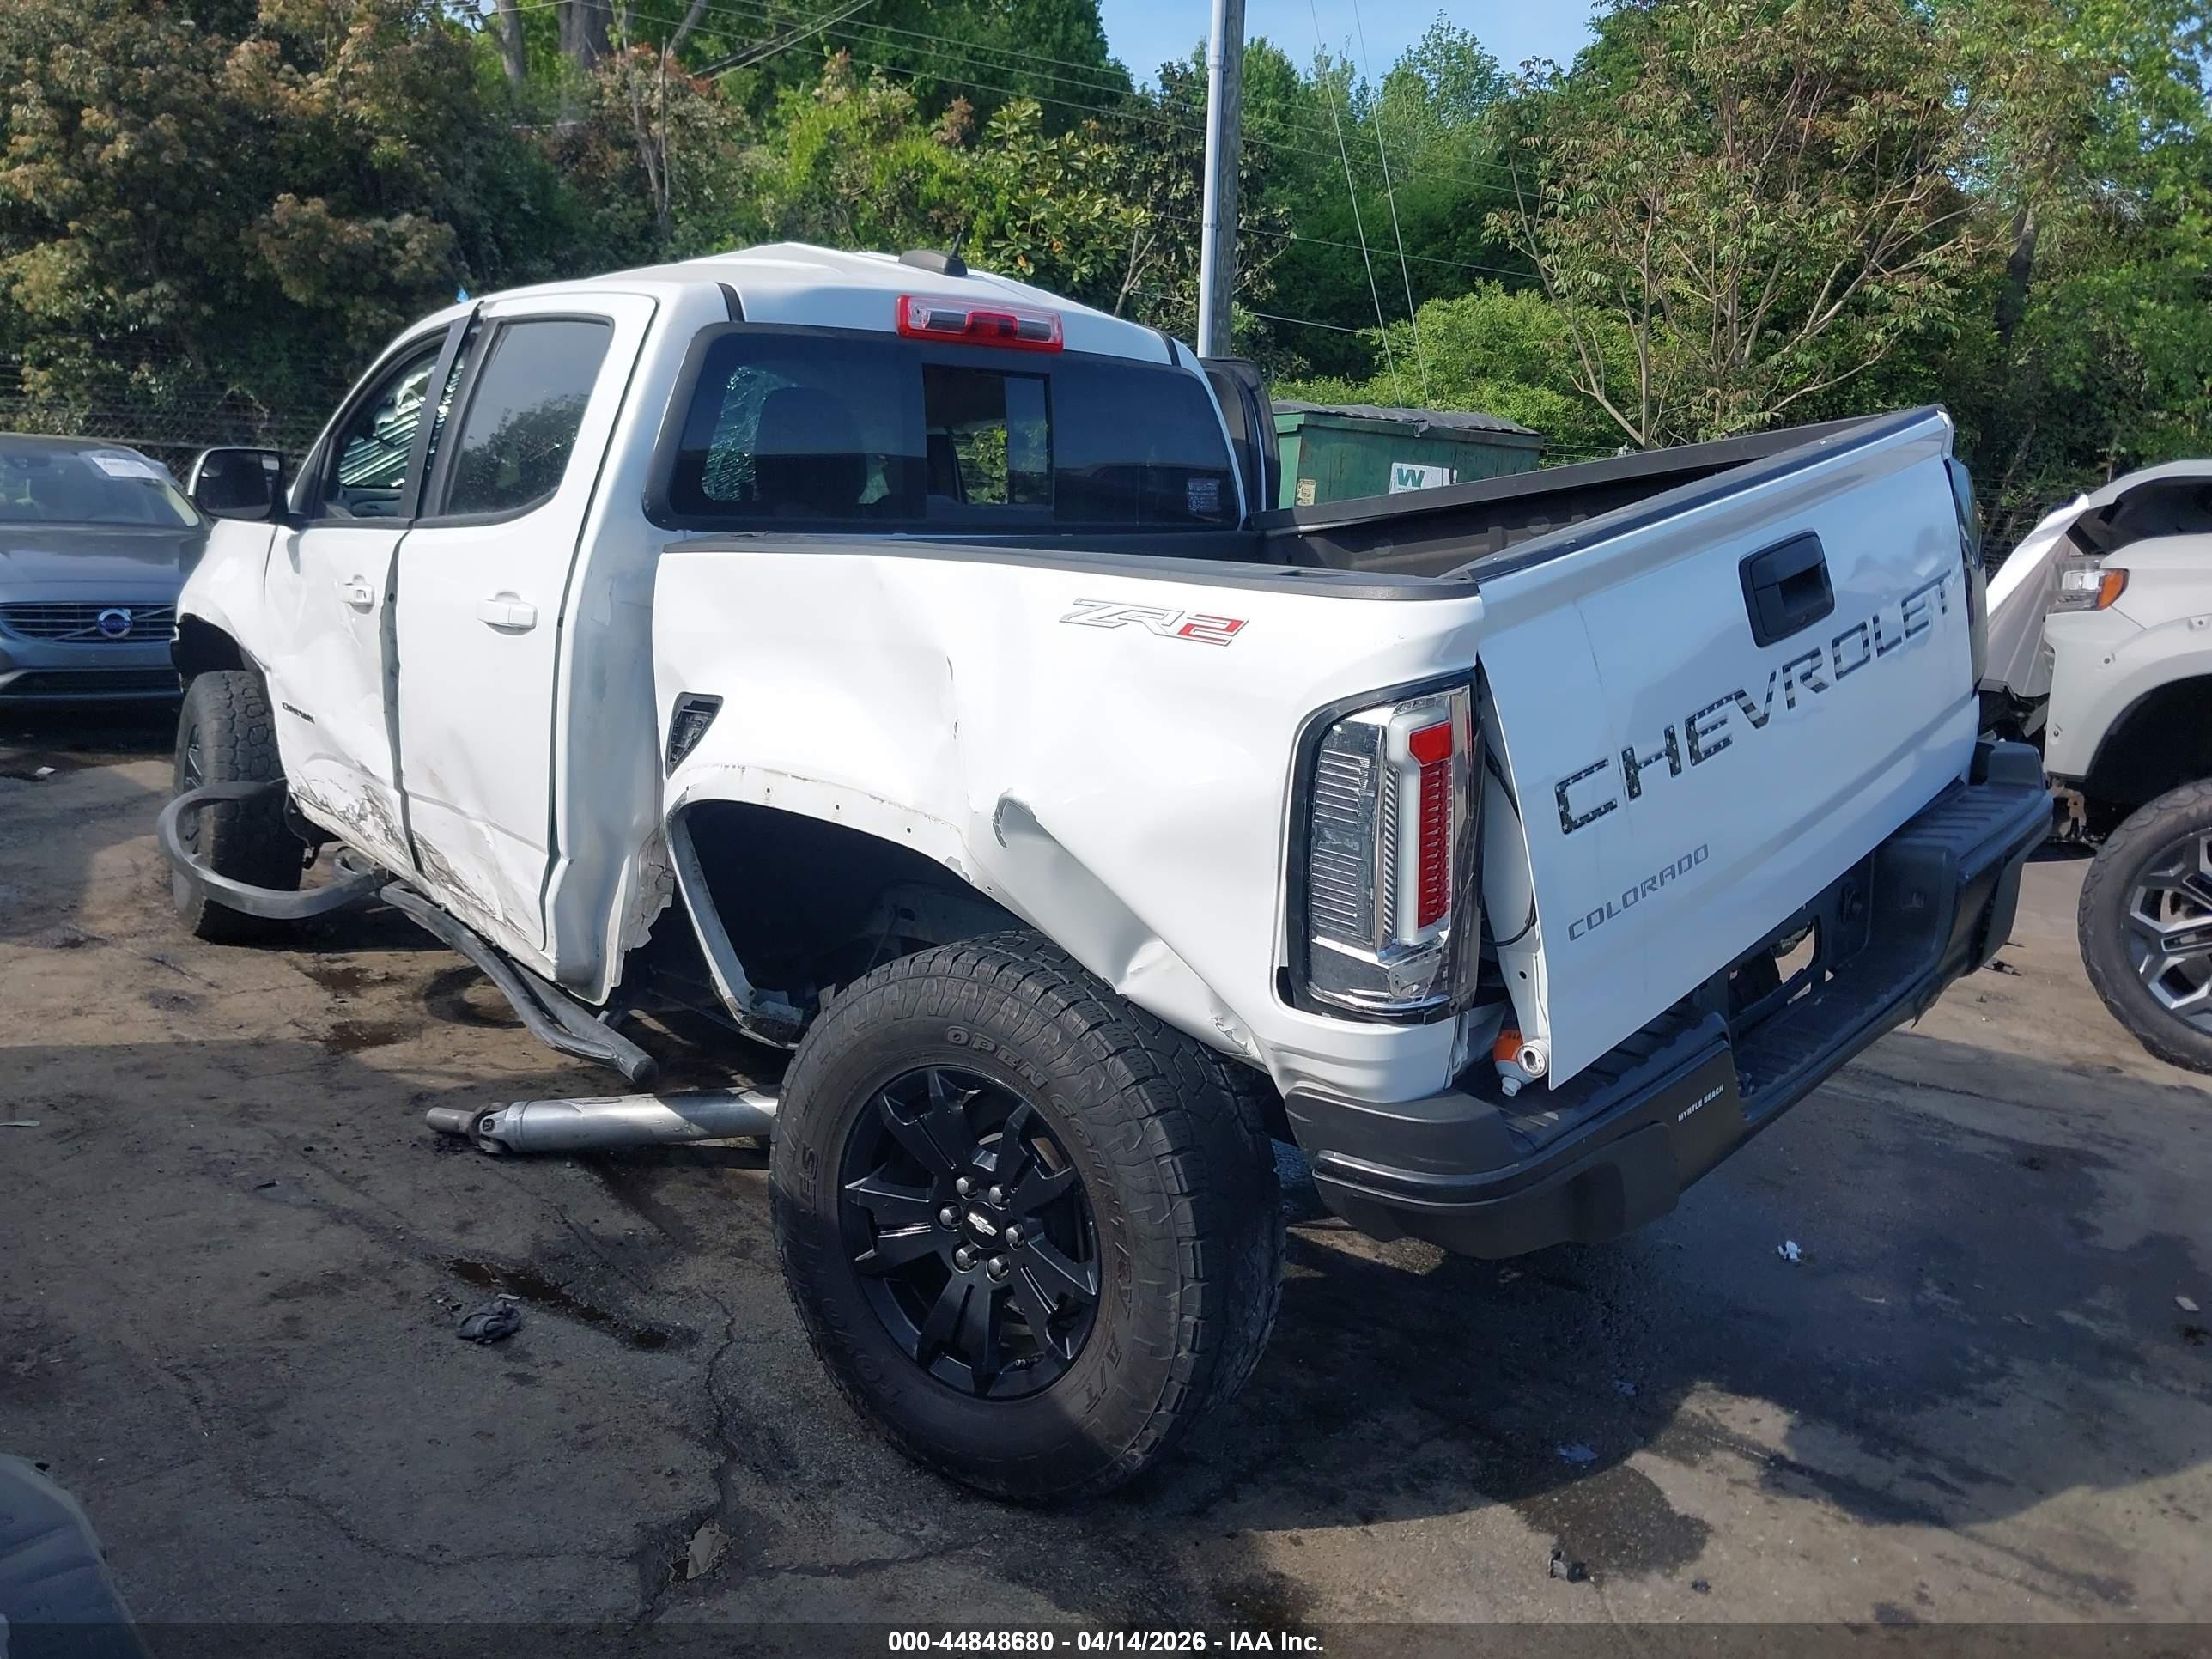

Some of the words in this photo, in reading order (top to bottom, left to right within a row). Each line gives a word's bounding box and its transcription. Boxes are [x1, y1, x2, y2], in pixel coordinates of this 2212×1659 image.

[1396, 467, 1425, 488] W
[1059, 598, 1249, 647] ZR2
[1554, 569, 1953, 835] CHEVROLET
[1568, 843, 1709, 942] COLORADO
[1678, 1099, 1703, 1122] MYRTLE
[1704, 1084, 1724, 1104] BEACH
[945, 1025, 1049, 1091] OPEN
[1085, 1326, 1122, 1415] A/T
